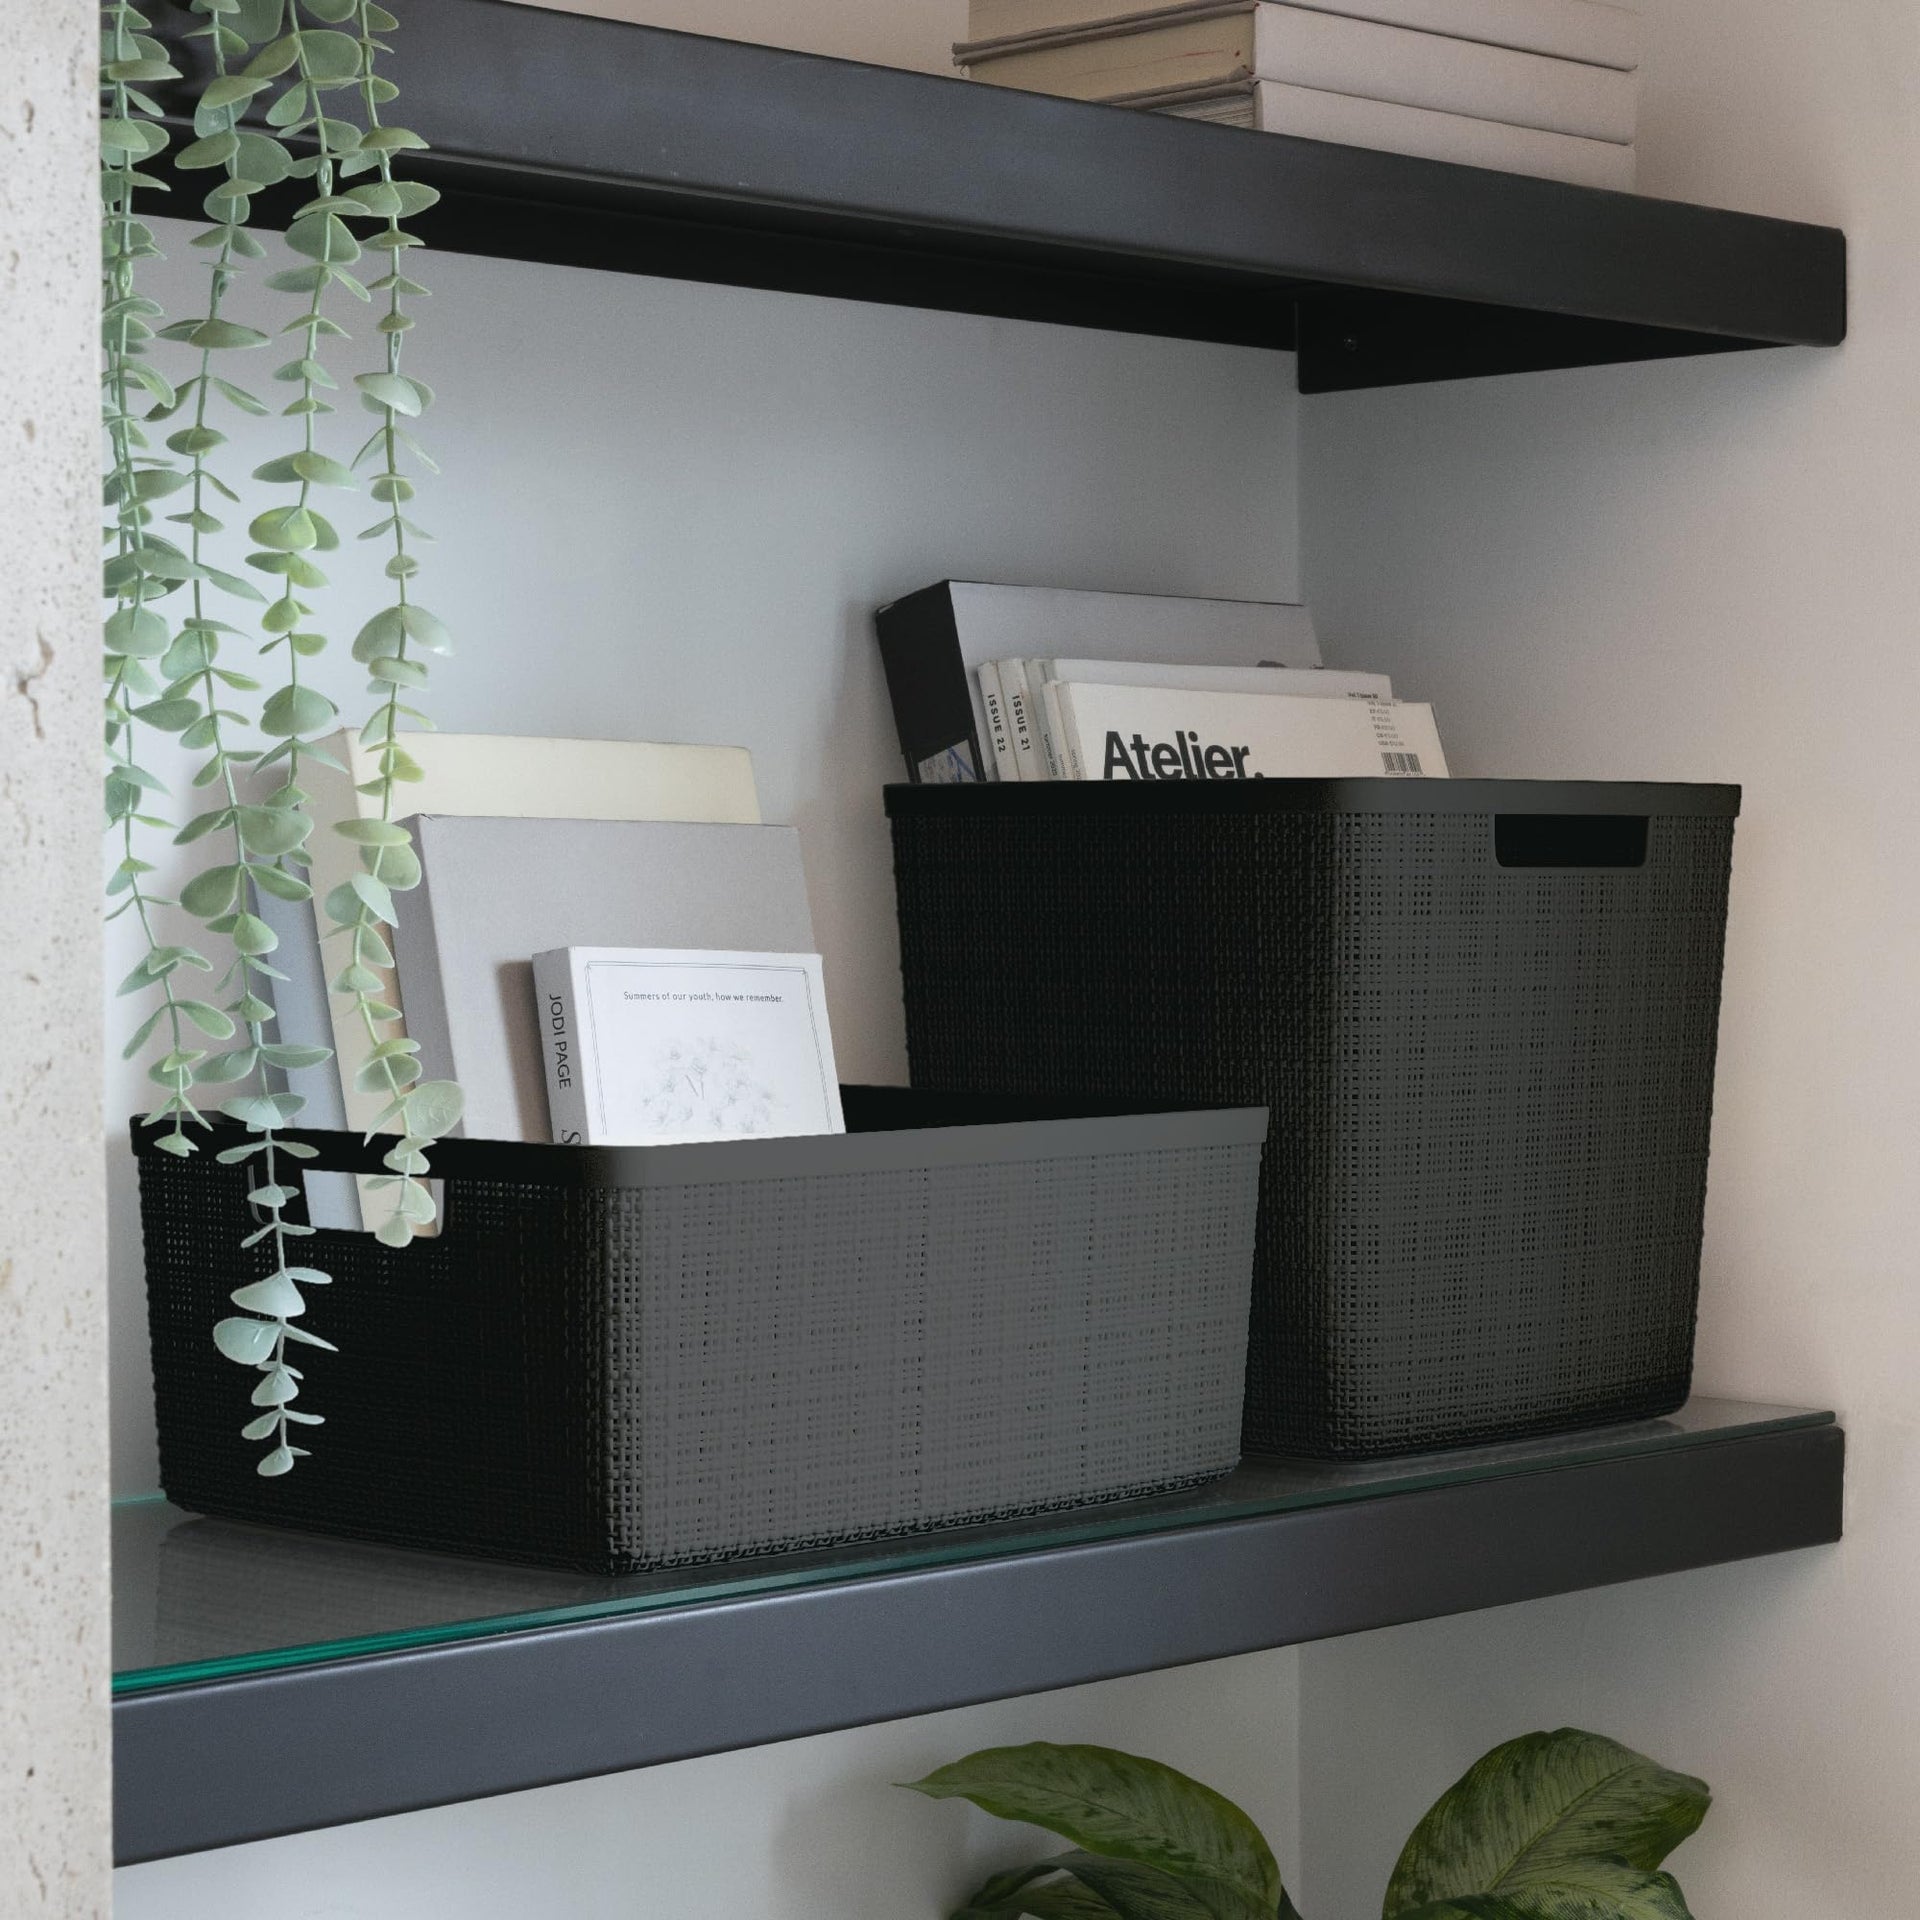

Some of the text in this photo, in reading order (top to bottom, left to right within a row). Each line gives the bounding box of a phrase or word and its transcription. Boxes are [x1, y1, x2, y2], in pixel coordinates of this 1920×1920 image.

[988, 694, 1006, 752] ISSUE 22
[1012, 695, 1031, 751] ISSUE 21
[1103, 730, 1264, 779] Atelier.
[623, 991, 660, 1001] Summers
[662, 992, 670, 1001] of
[673, 993, 686, 1001] our
[688, 992, 714, 1002] youth,
[715, 992, 731, 1001] how
[746, 993, 784, 1003] remember.
[549, 994, 571, 1090] JODI PAGE
